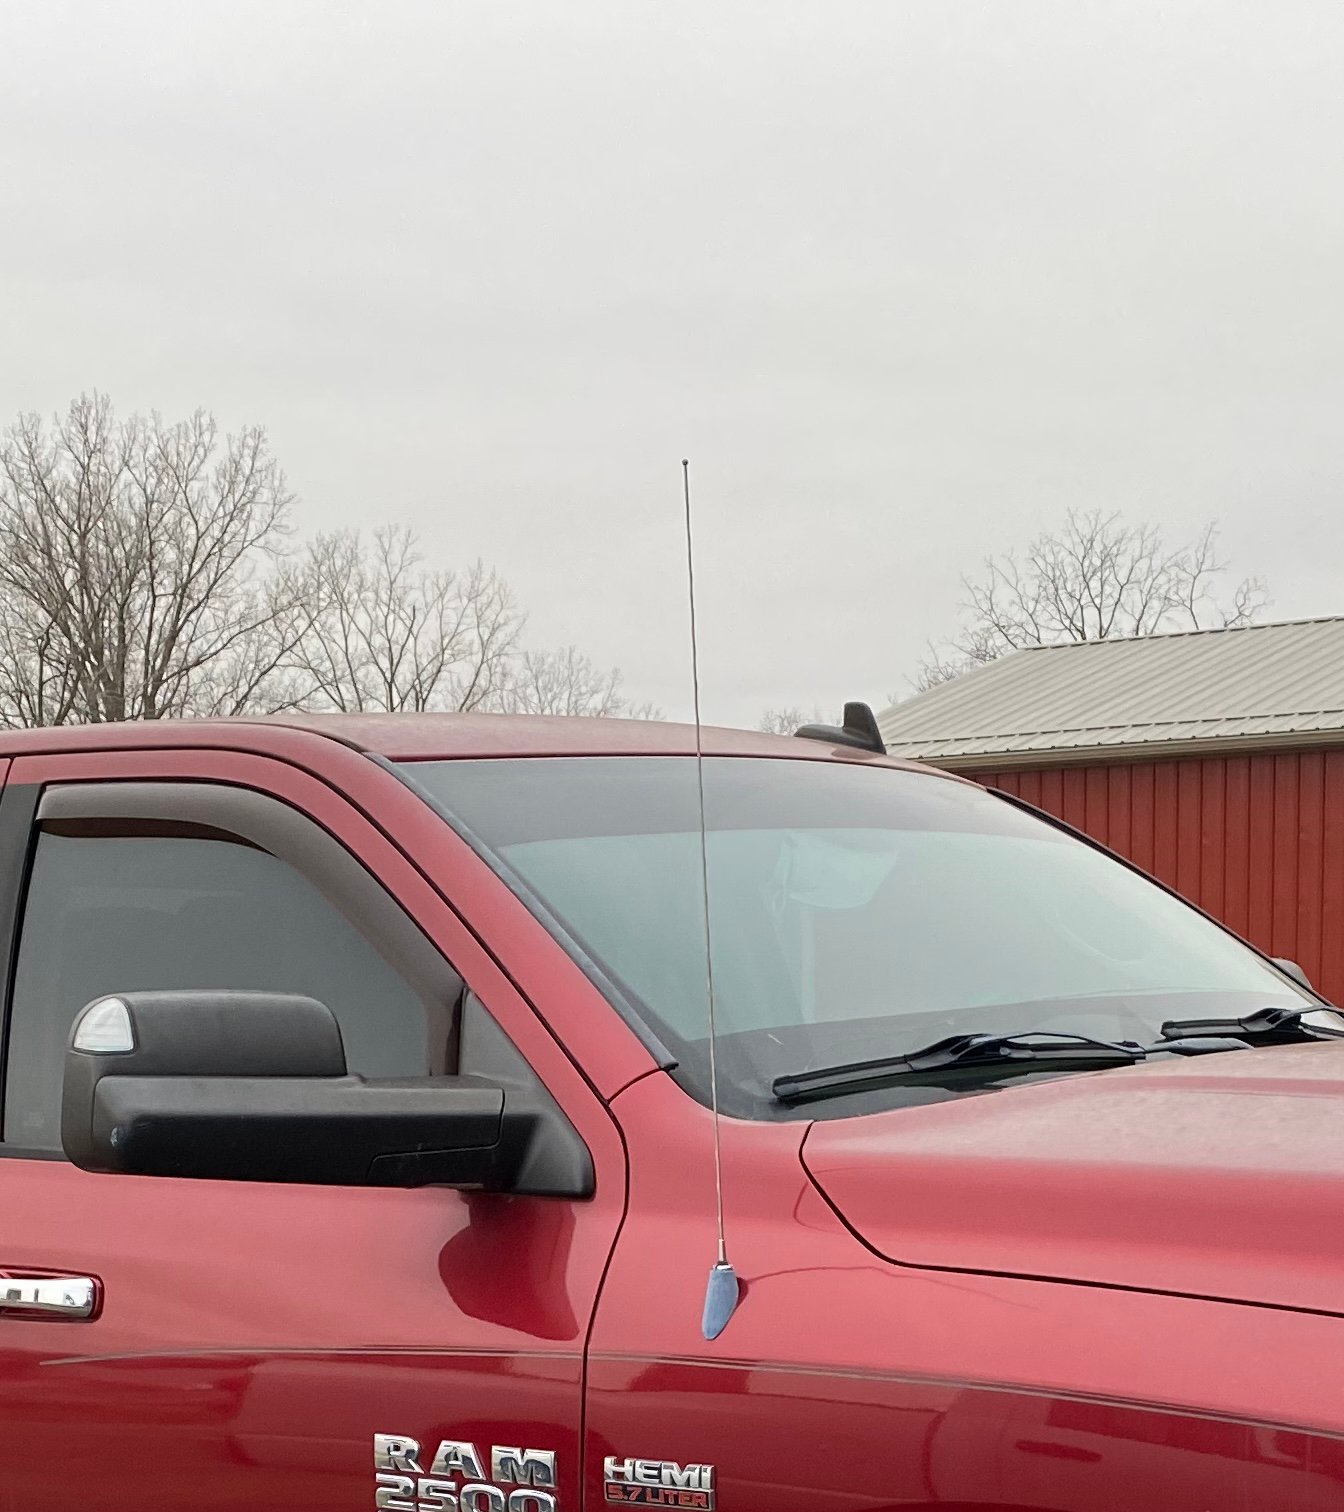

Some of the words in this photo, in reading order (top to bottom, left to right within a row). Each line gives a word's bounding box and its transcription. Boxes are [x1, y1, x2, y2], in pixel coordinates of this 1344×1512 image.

[373, 1433, 557, 1487] RAM
[603, 1456, 716, 1489] HEMI
[607, 1485, 641, 1501] 5.7
[645, 1488, 709, 1508] LITER
